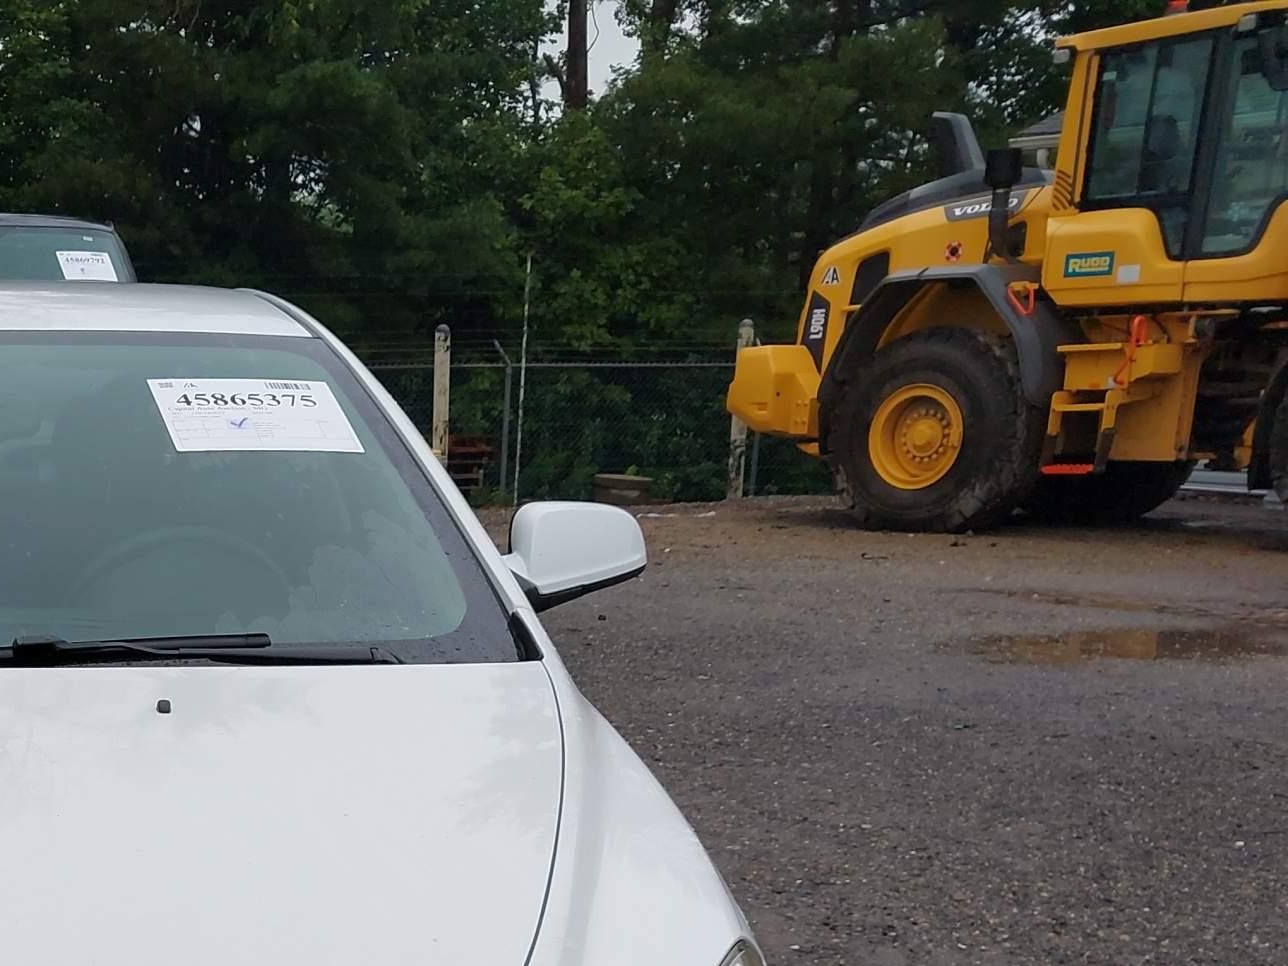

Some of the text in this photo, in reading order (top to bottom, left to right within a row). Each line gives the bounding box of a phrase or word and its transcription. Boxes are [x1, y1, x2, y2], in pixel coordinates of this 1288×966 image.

[953, 198, 1019, 216] VOLO
[809, 308, 827, 340] L90H
[176, 392, 318, 408] 45865375
